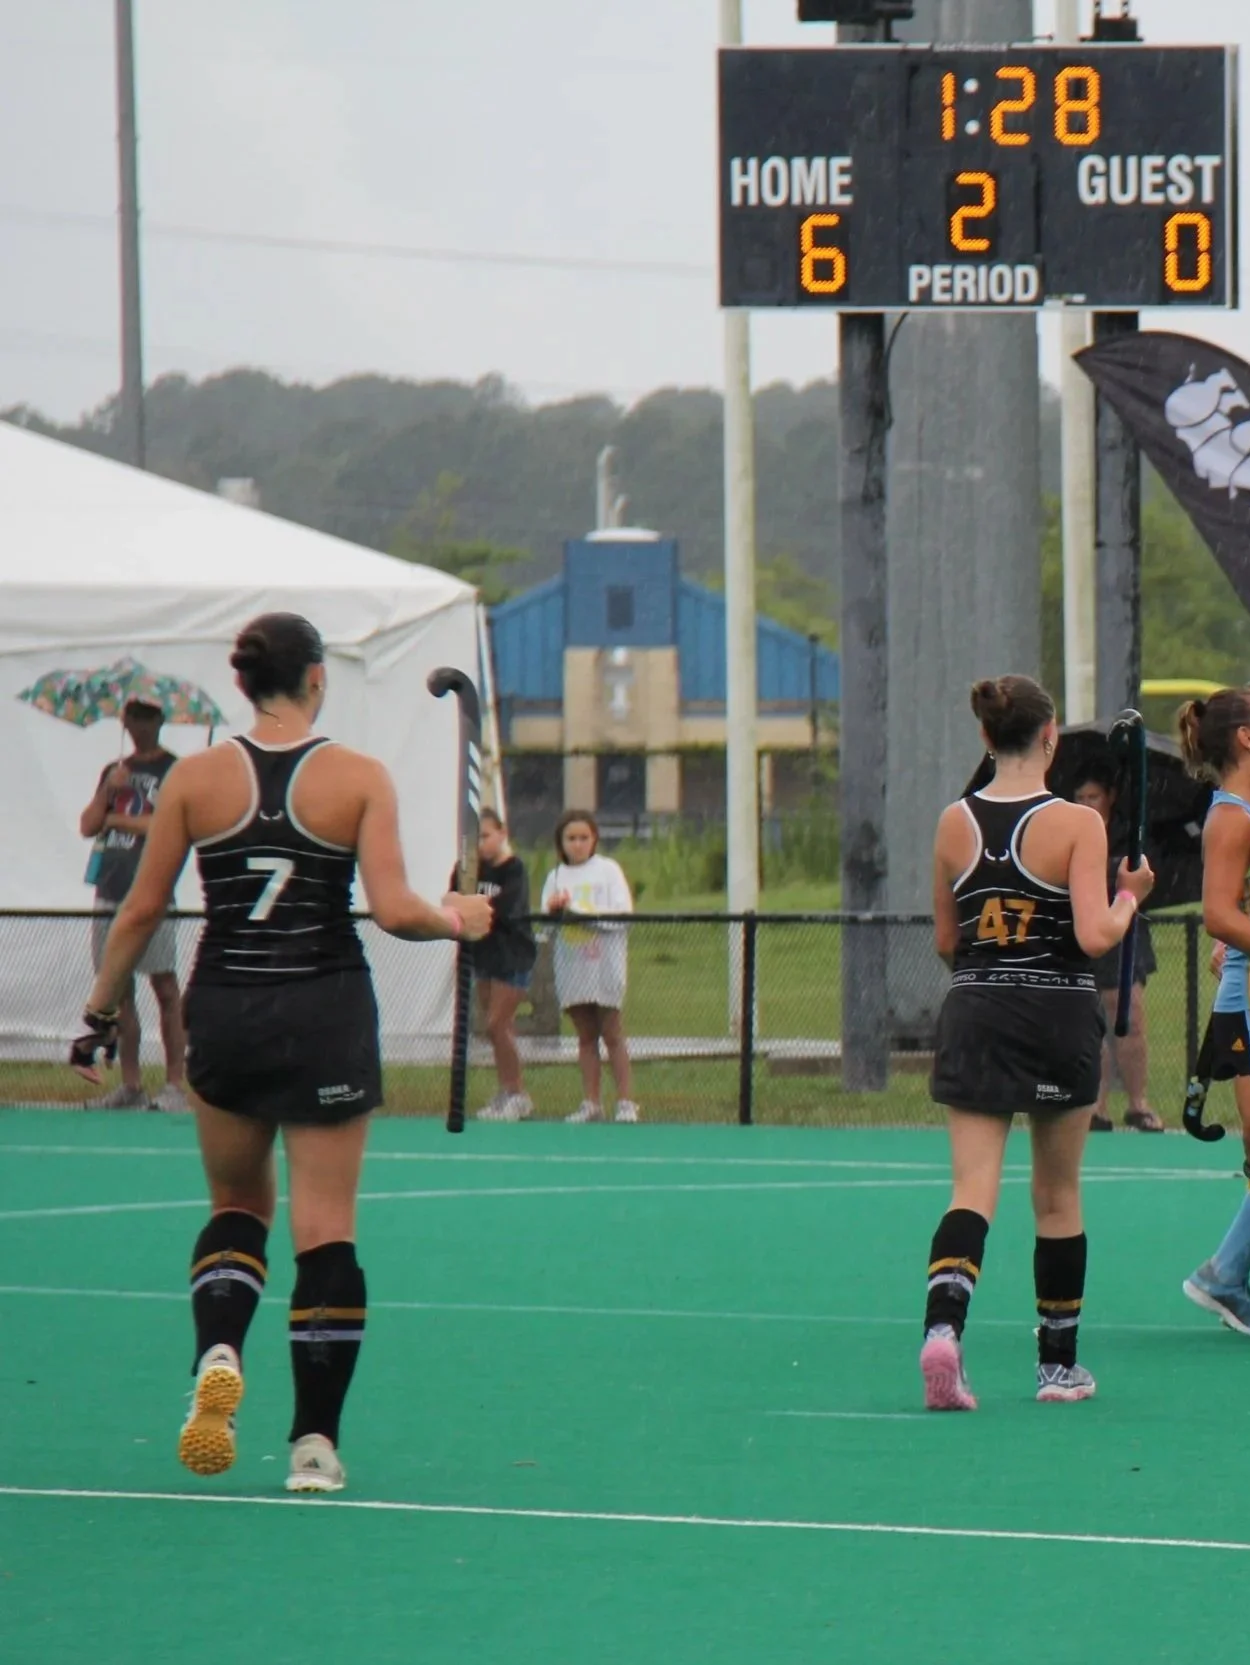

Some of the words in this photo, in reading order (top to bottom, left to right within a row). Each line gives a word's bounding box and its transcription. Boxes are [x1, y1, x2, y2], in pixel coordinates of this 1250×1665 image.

[943, 66, 1100, 146] 1:28
[731, 157, 853, 206] HOME
[950, 171, 996, 252] 2
[1078, 155, 1222, 205] GUEST
[800, 213, 846, 293] 6
[909, 264, 1038, 302] PERIOD
[1164, 212, 1211, 291] 0
[246, 857, 295, 921] 7
[977, 897, 1036, 947] 47
